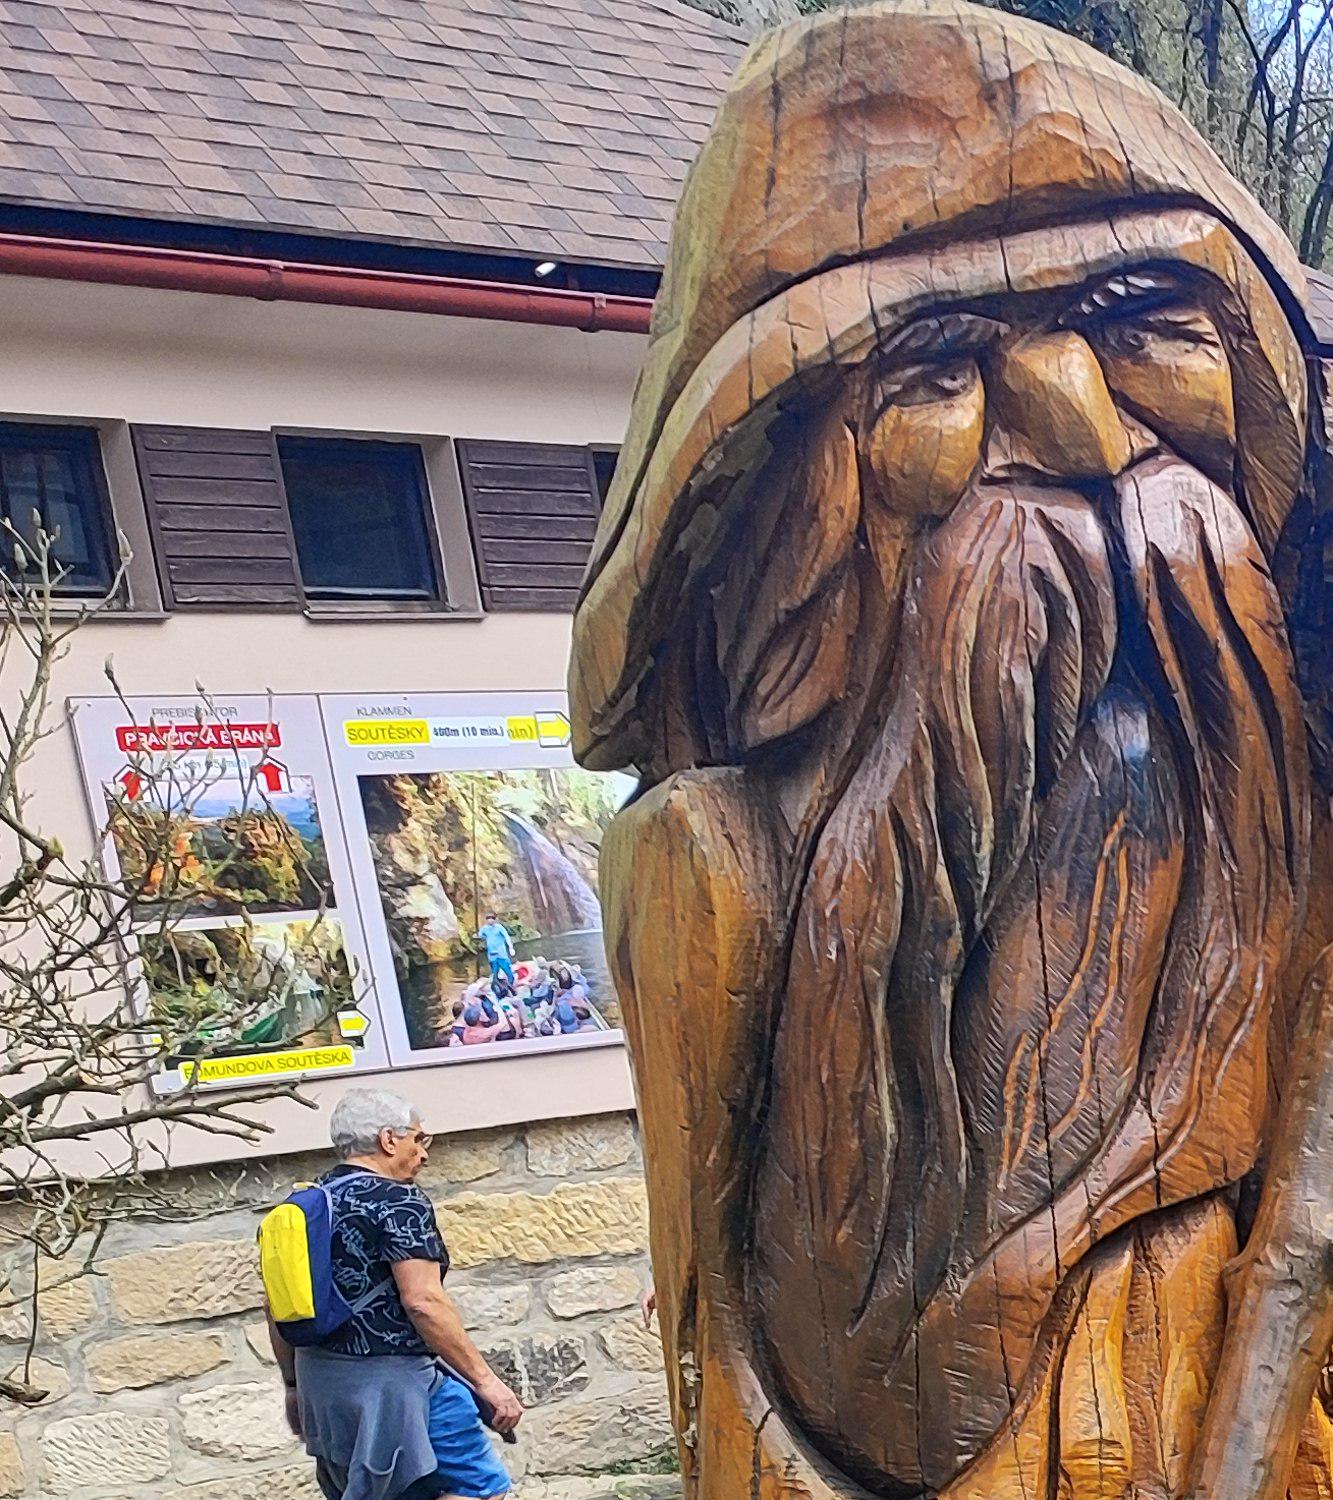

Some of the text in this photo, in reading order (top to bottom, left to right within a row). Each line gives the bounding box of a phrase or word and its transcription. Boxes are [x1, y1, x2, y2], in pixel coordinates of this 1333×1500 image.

[151, 706, 239, 718] PREBISTOR
[356, 706, 413, 717] KLAMMEN
[347, 724, 425, 741] SOUTĚSKY
[367, 749, 416, 761] GORGES
[277, 1050, 351, 1070] SOUTĚSKA
